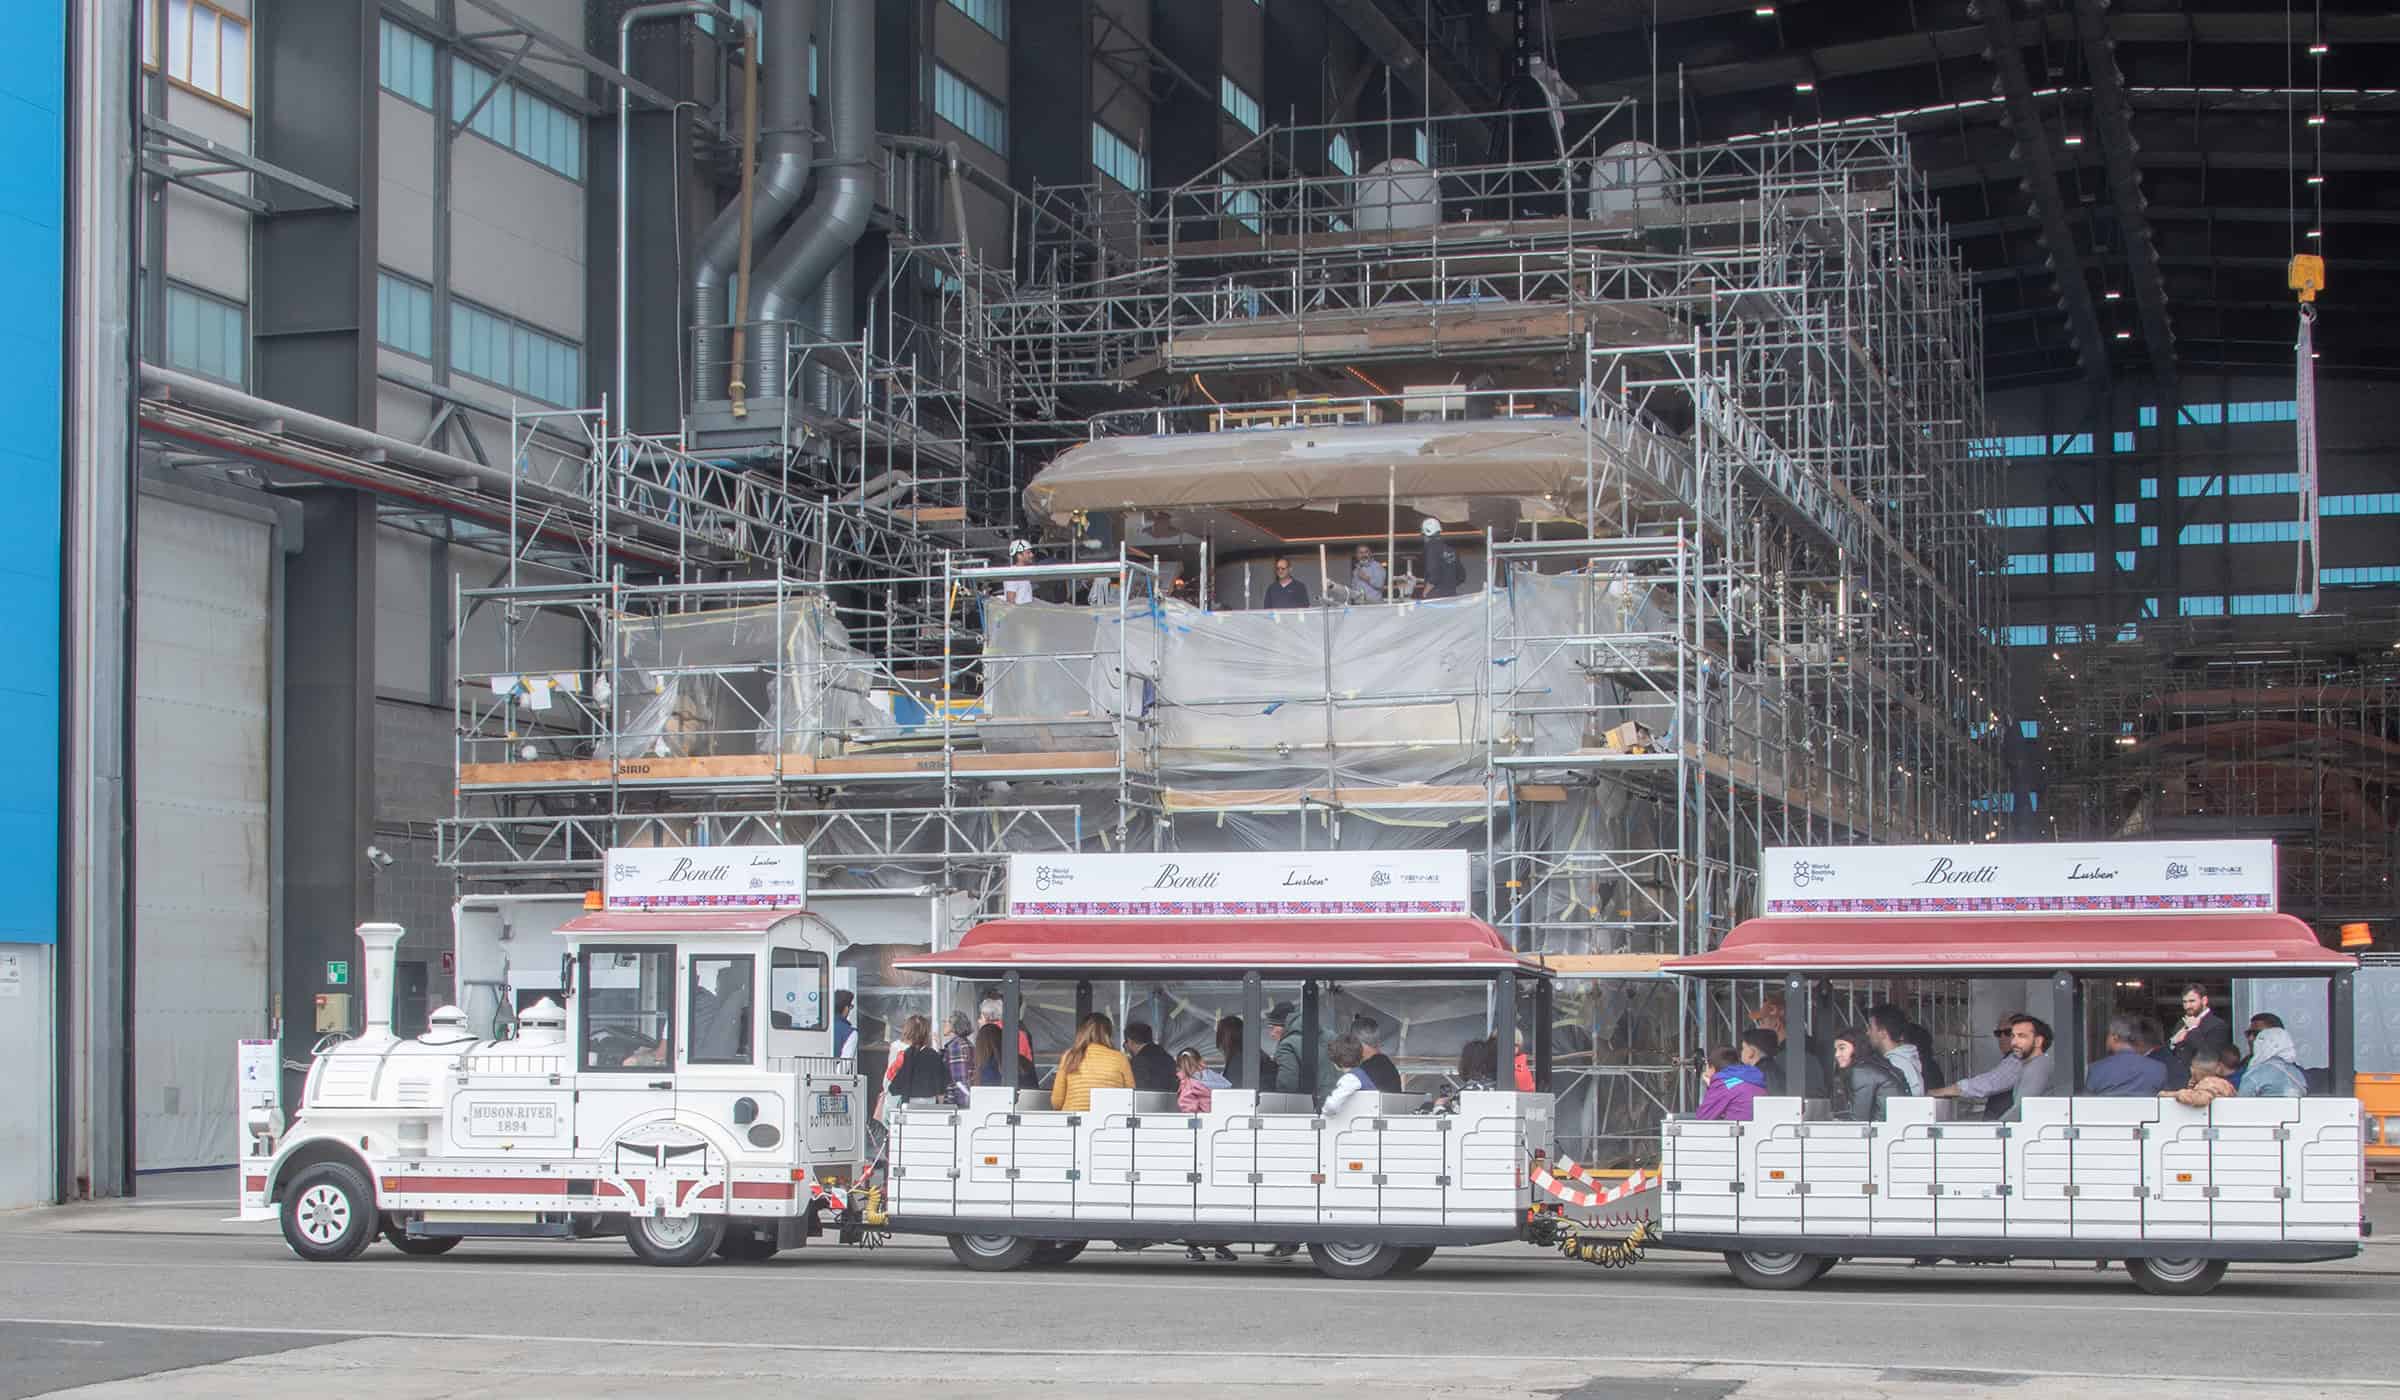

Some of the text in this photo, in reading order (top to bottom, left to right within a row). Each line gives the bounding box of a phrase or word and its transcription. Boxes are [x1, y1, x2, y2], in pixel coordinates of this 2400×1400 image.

[619, 765, 650, 774] SIRIO
[656, 857, 730, 884] Benetti
[1142, 863, 1221, 889] Benetti
[1282, 870, 1324, 886] Lusben
[1912, 857, 1999, 885] Benetti
[2067, 863, 2114, 880] Lusben
[496, 1120, 527, 1132] 1894
